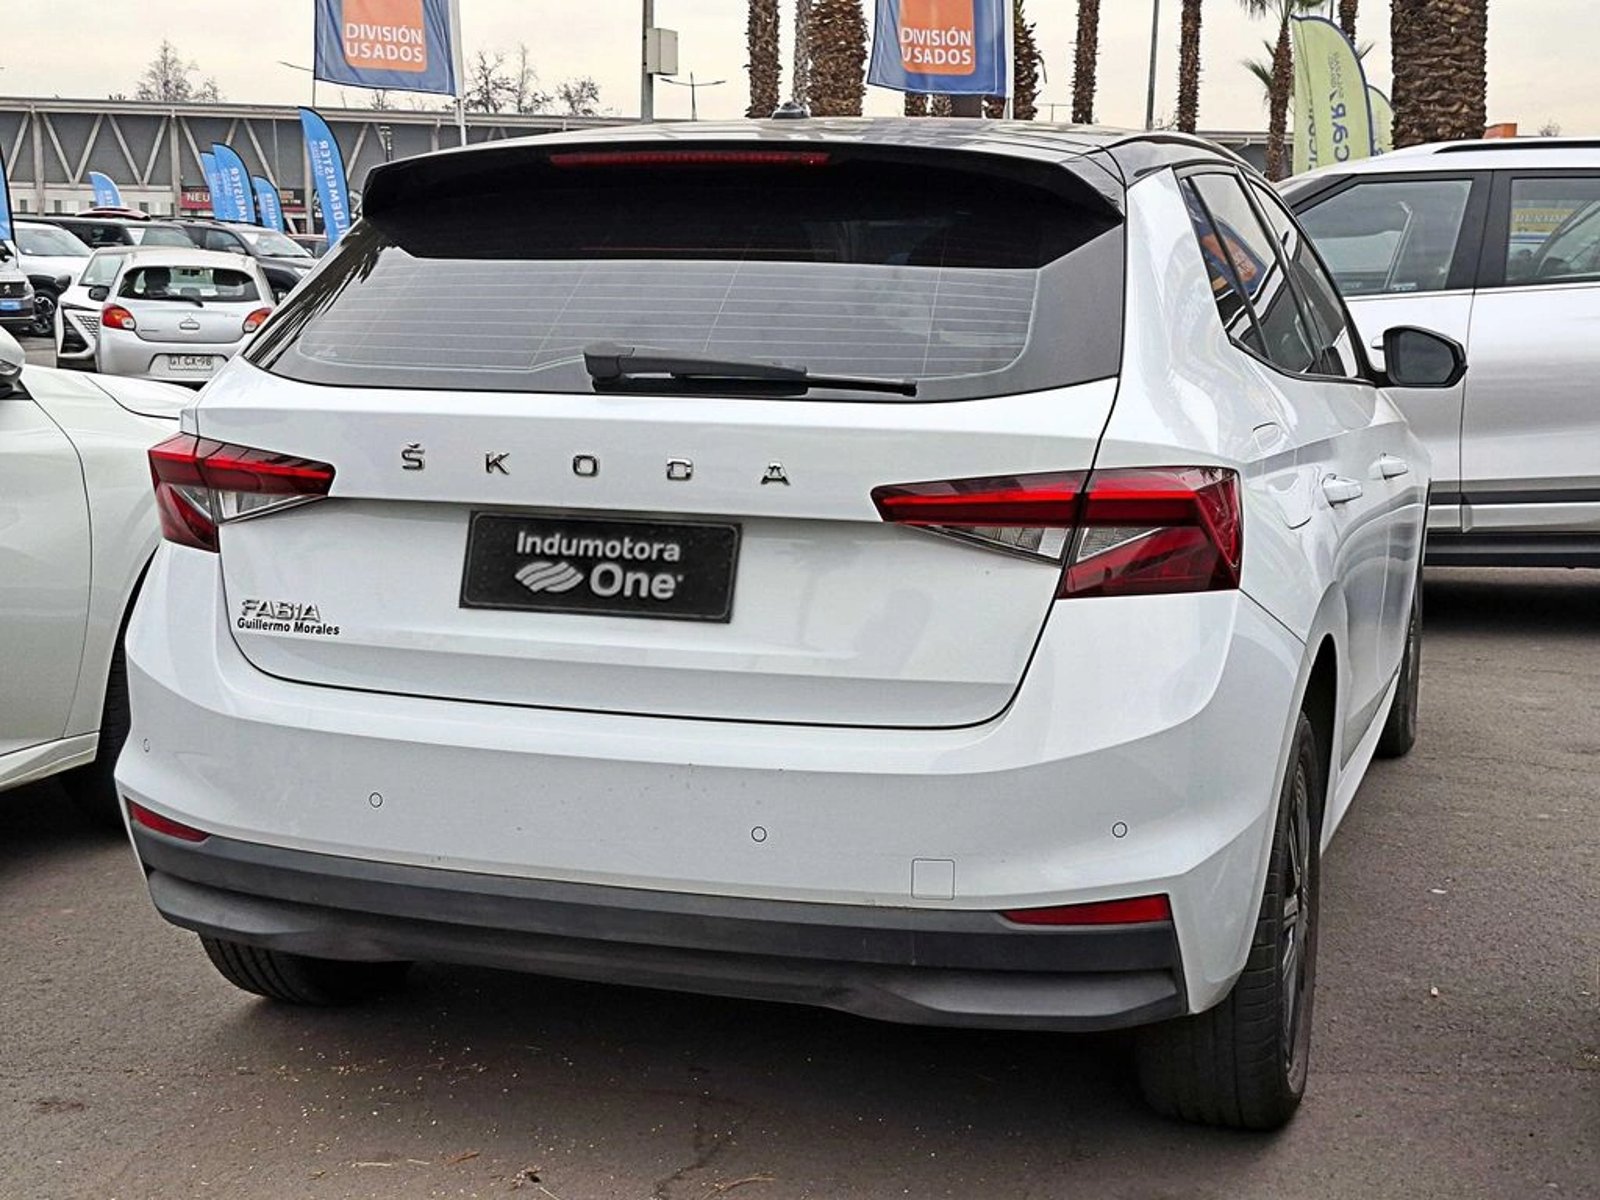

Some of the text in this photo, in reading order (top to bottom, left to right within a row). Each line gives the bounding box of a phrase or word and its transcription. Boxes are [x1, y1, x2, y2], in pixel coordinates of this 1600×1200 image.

[346, 23, 422, 44] DIVISIÓN
[901, 26, 971, 46] DIVISIÓN
[346, 42, 423, 63] USADOS
[901, 46, 971, 65] USADOS
[186, 191, 210, 203] NEU
[401, 443, 790, 486] ŠKODA
[516, 531, 681, 561] Indumotora
[590, 562, 677, 599] One
[241, 600, 321, 623] FABIA
[237, 617, 340, 635] Guillermo Morales
